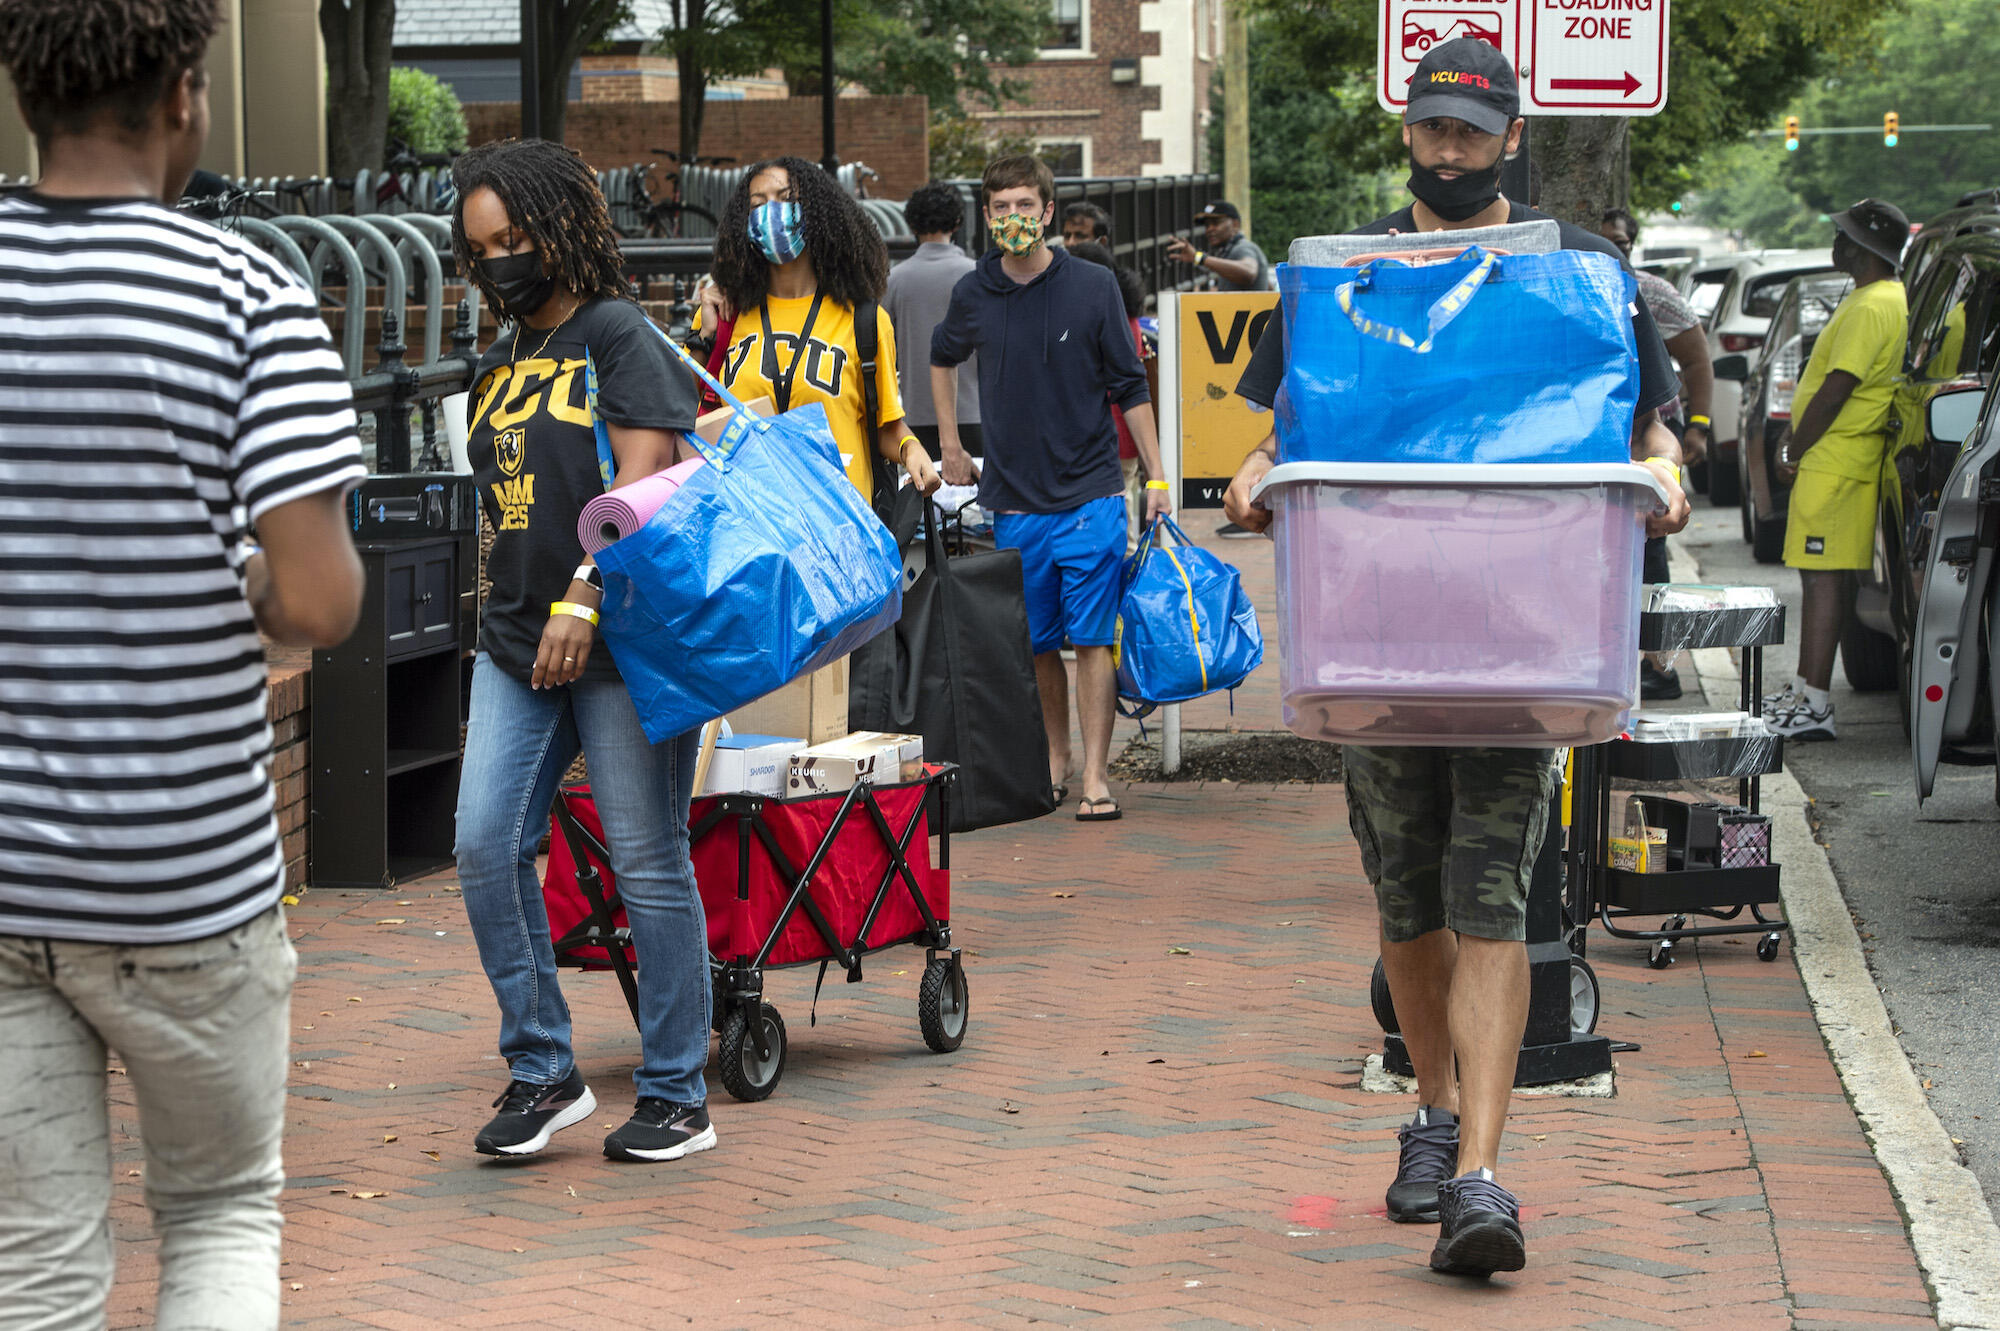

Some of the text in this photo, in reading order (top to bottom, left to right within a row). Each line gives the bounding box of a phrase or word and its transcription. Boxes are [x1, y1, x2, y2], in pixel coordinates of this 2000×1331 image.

[1564, 16, 1632, 39] ZONE
[725, 332, 847, 397] VCU
[791, 766, 826, 778] KEURIG
